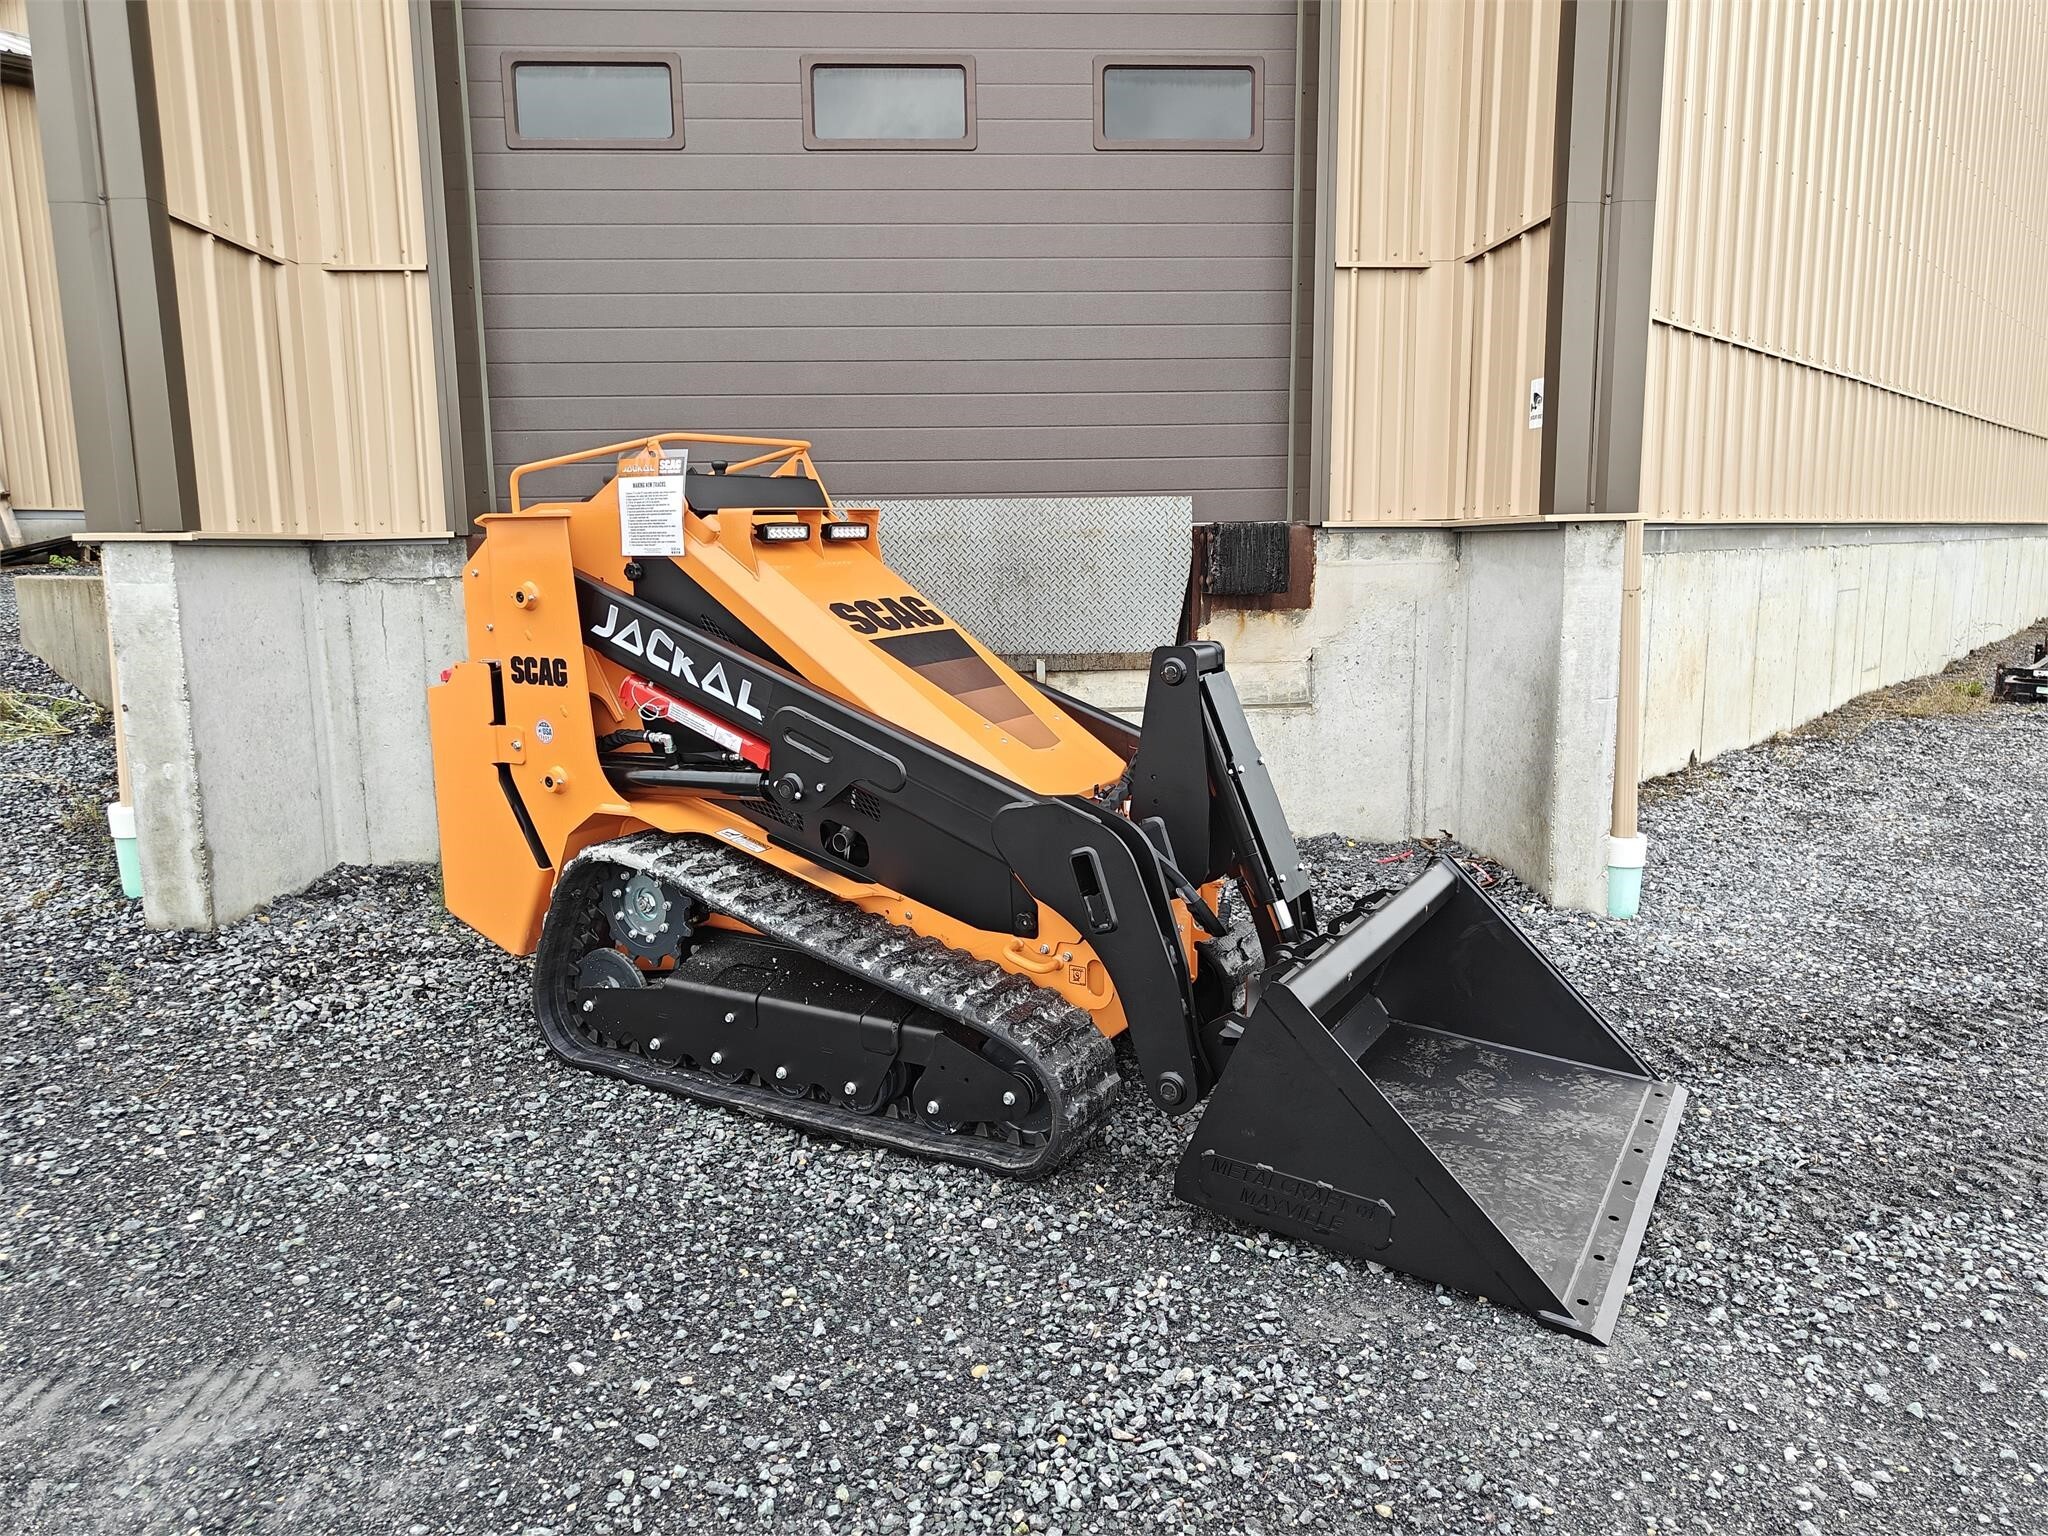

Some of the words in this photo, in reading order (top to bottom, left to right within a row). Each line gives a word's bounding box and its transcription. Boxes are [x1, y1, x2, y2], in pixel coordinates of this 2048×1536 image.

[659, 459, 682, 470] SCAG
[829, 596, 945, 635] SCAG
[511, 655, 568, 687] SCAG
[591, 604, 763, 721] JACKAL
[1211, 1157, 1349, 1212] METALCRAFT
[1240, 1186, 1345, 1230] MAYVILLE
